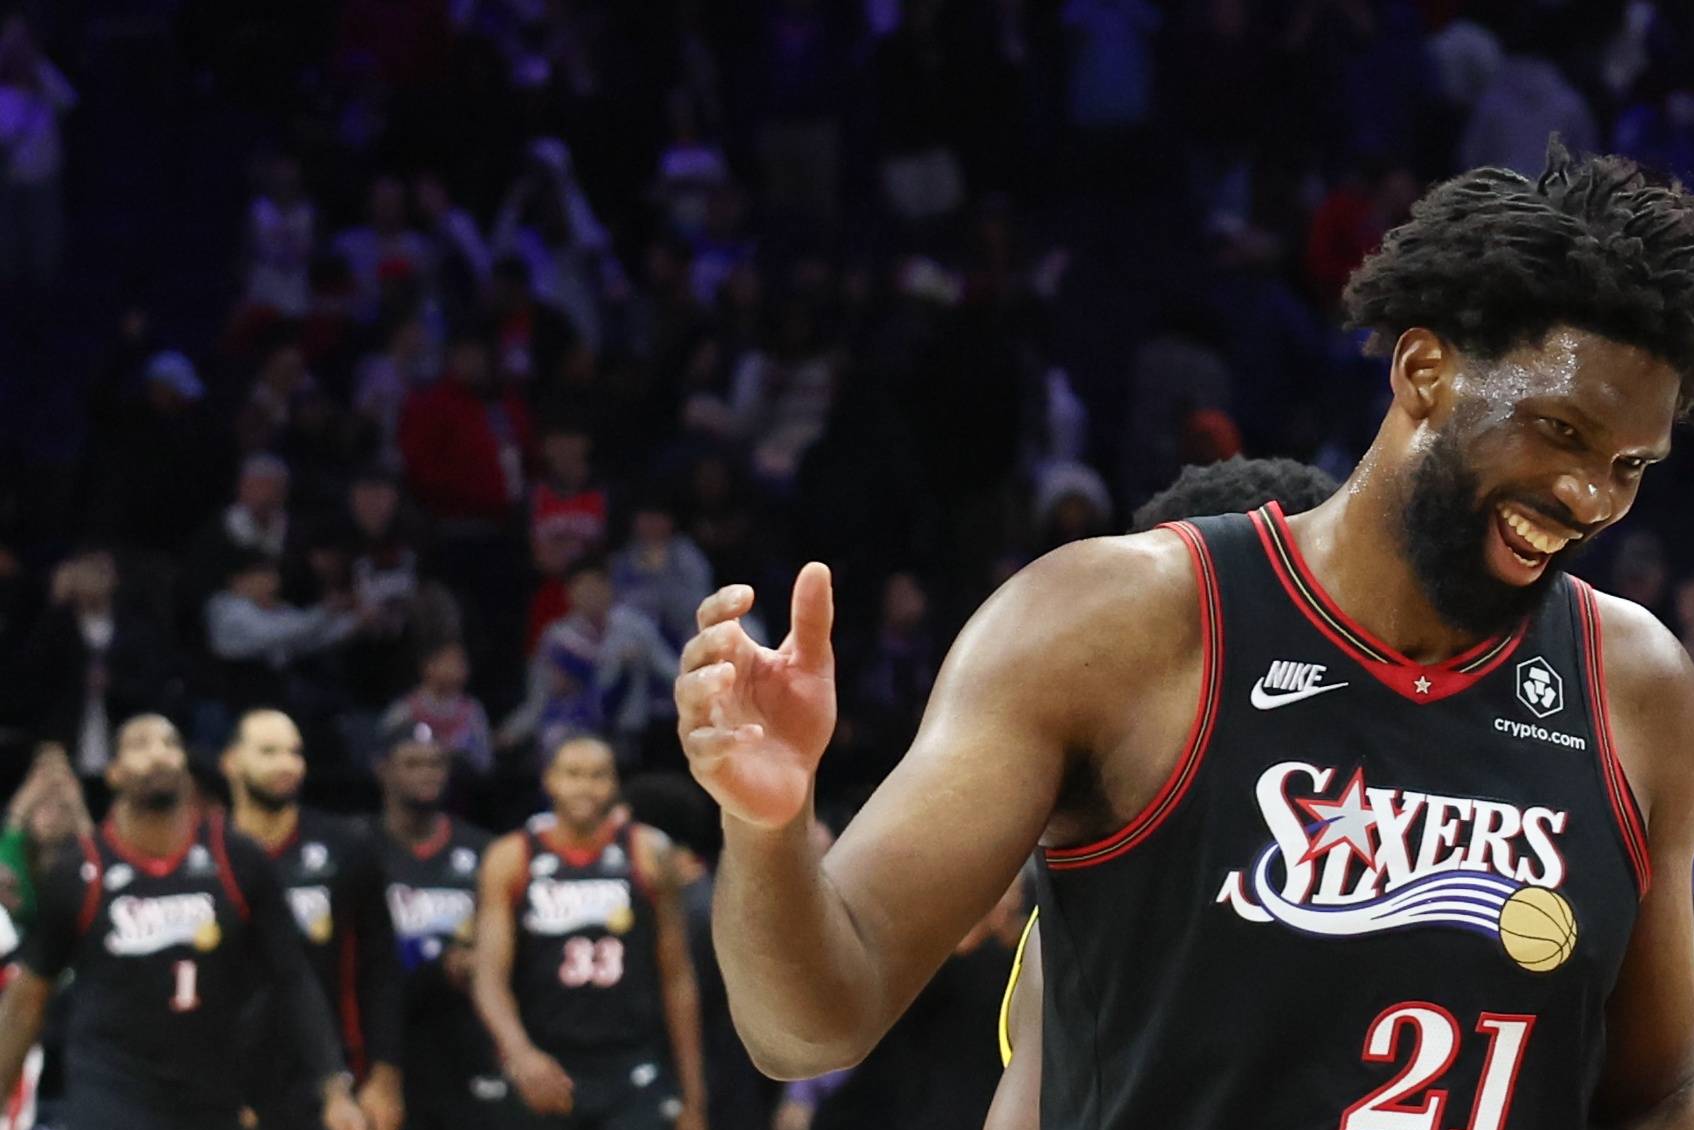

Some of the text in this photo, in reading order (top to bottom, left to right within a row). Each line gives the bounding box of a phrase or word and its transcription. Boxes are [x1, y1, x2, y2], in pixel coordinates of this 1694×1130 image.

[1262, 660, 1328, 692] NIKE
[1493, 718, 1586, 751] crypto.com
[558, 936, 625, 989] 33
[170, 959, 201, 1013] 1
